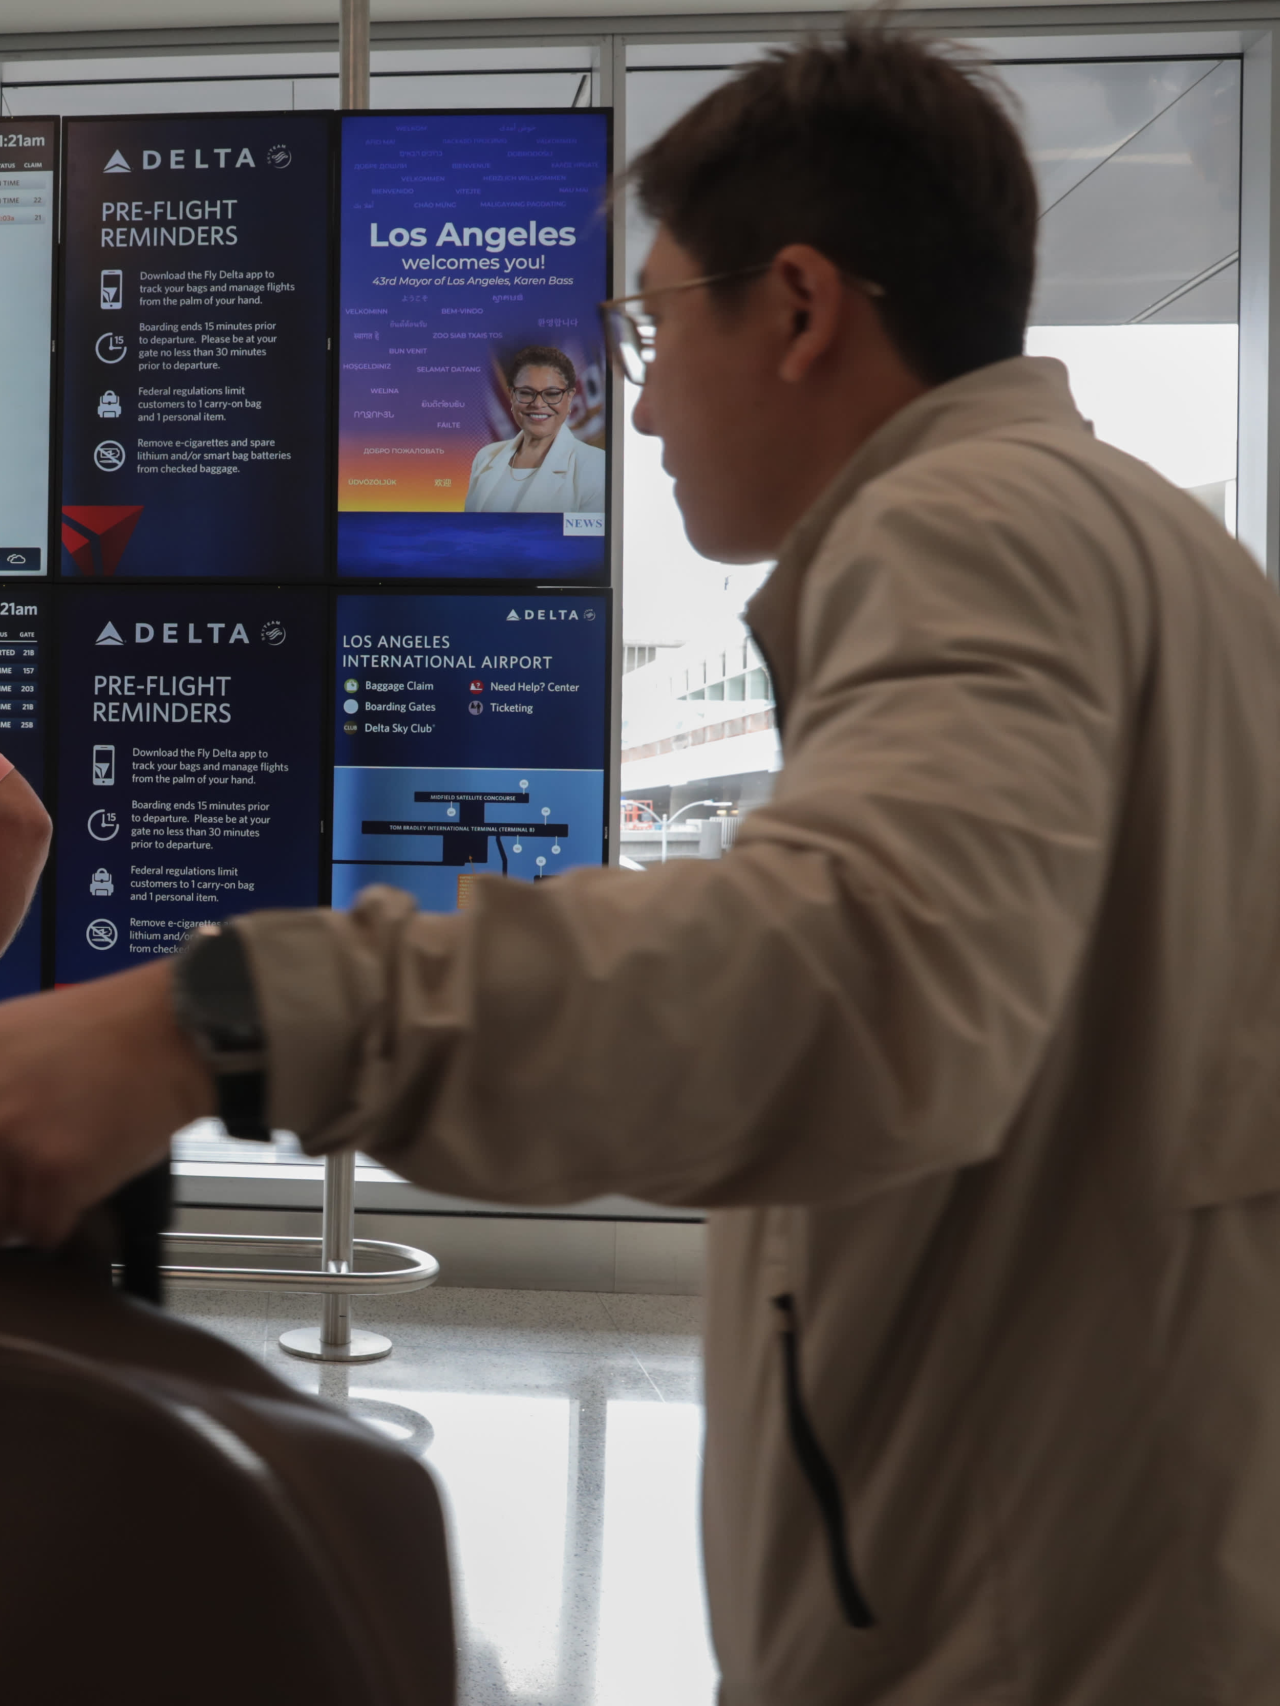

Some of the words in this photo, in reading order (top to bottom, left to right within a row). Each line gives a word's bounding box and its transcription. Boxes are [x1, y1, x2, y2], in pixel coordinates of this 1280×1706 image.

[143, 148, 255, 170] DELTA
[102, 200, 238, 221] PRE-FLIGHT
[101, 225, 238, 247] REMINDERS
[371, 223, 427, 247] Los
[435, 221, 576, 253] Angeles
[402, 254, 500, 270] welcomes
[504, 254, 545, 273] you!
[140, 271, 186, 280] Download
[187, 270, 202, 280] the
[204, 270, 217, 281] Fly
[219, 270, 244, 279] Delta
[245, 272, 263, 280] app
[264, 270, 275, 279] to
[372, 276, 397, 286] 43rd
[399, 277, 432, 287] Mayor
[434, 276, 446, 285] of
[447, 277, 465, 285] Los
[466, 276, 511, 287] Angeles,
[514, 276, 546, 285] Karen
[548, 276, 573, 285] Bass
[139, 284, 162, 293] track
[164, 286, 184, 294] your
[186, 283, 208, 294] bags
[209, 283, 227, 292] and
[229, 285, 265, 293] manage
[267, 282, 295, 293] flights
[139, 297, 161, 306] from
[163, 296, 178, 306] the
[180, 296, 202, 307] palm
[204, 296, 213, 305] of
[215, 298, 236, 306] your
[237, 295, 262, 305] hand.
[138, 438, 173, 448] Remove
[175, 438, 229, 450] e-cigarettes
[231, 438, 248, 447] and
[250, 440, 276, 449] spare
[137, 451, 168, 460] lithium
[170, 451, 201, 461] and/or
[203, 452, 230, 460] smart
[232, 451, 249, 462] bag
[251, 451, 291, 460] batteries
[137, 464, 158, 473] from
[160, 464, 198, 473] checked
[199, 464, 240, 475] baggage.
[434, 479, 451, 487] 欢迎
[565, 518, 603, 529] NEWS
[525, 610, 578, 620] DELTA
[135, 623, 249, 644] DELTA
[343, 635, 372, 648] LOS
[377, 635, 450, 649] ANGELES
[343, 655, 476, 668] INTERNATIONAL
[481, 656, 552, 669] AIRPORT
[94, 675, 231, 696] PRE-FLIGHT
[365, 681, 404, 692] Baggage
[407, 681, 434, 690] Claim
[491, 682, 516, 691] Need
[518, 682, 545, 693] Help?
[547, 682, 579, 692] Center
[93, 702, 231, 723] REMINDERS
[365, 701, 406, 713] Boarding
[408, 702, 436, 712] Gates
[490, 703, 533, 714] Ticketing
[365, 723, 390, 733] Delta
[392, 723, 408, 734] Sky
[131, 800, 172, 812] Boarding
[173, 801, 195, 810] ends
[197, 801, 207, 810] 15
[209, 801, 246, 811] minutes
[248, 802, 270, 812] prior
[131, 814, 141, 822] to
[142, 813, 189, 824] departure.
[194, 814, 224, 823] Please
[225, 814, 237, 824] be
[239, 815, 248, 824] at
[250, 814, 271, 825] your
[131, 827, 151, 838] gate
[166, 827, 184, 836] less
[186, 827, 207, 836] than
[209, 827, 221, 837] 30
[223, 827, 260, 838] minutes
[131, 840, 153, 850] prior
[155, 840, 165, 849] to
[166, 840, 213, 850] departure.
